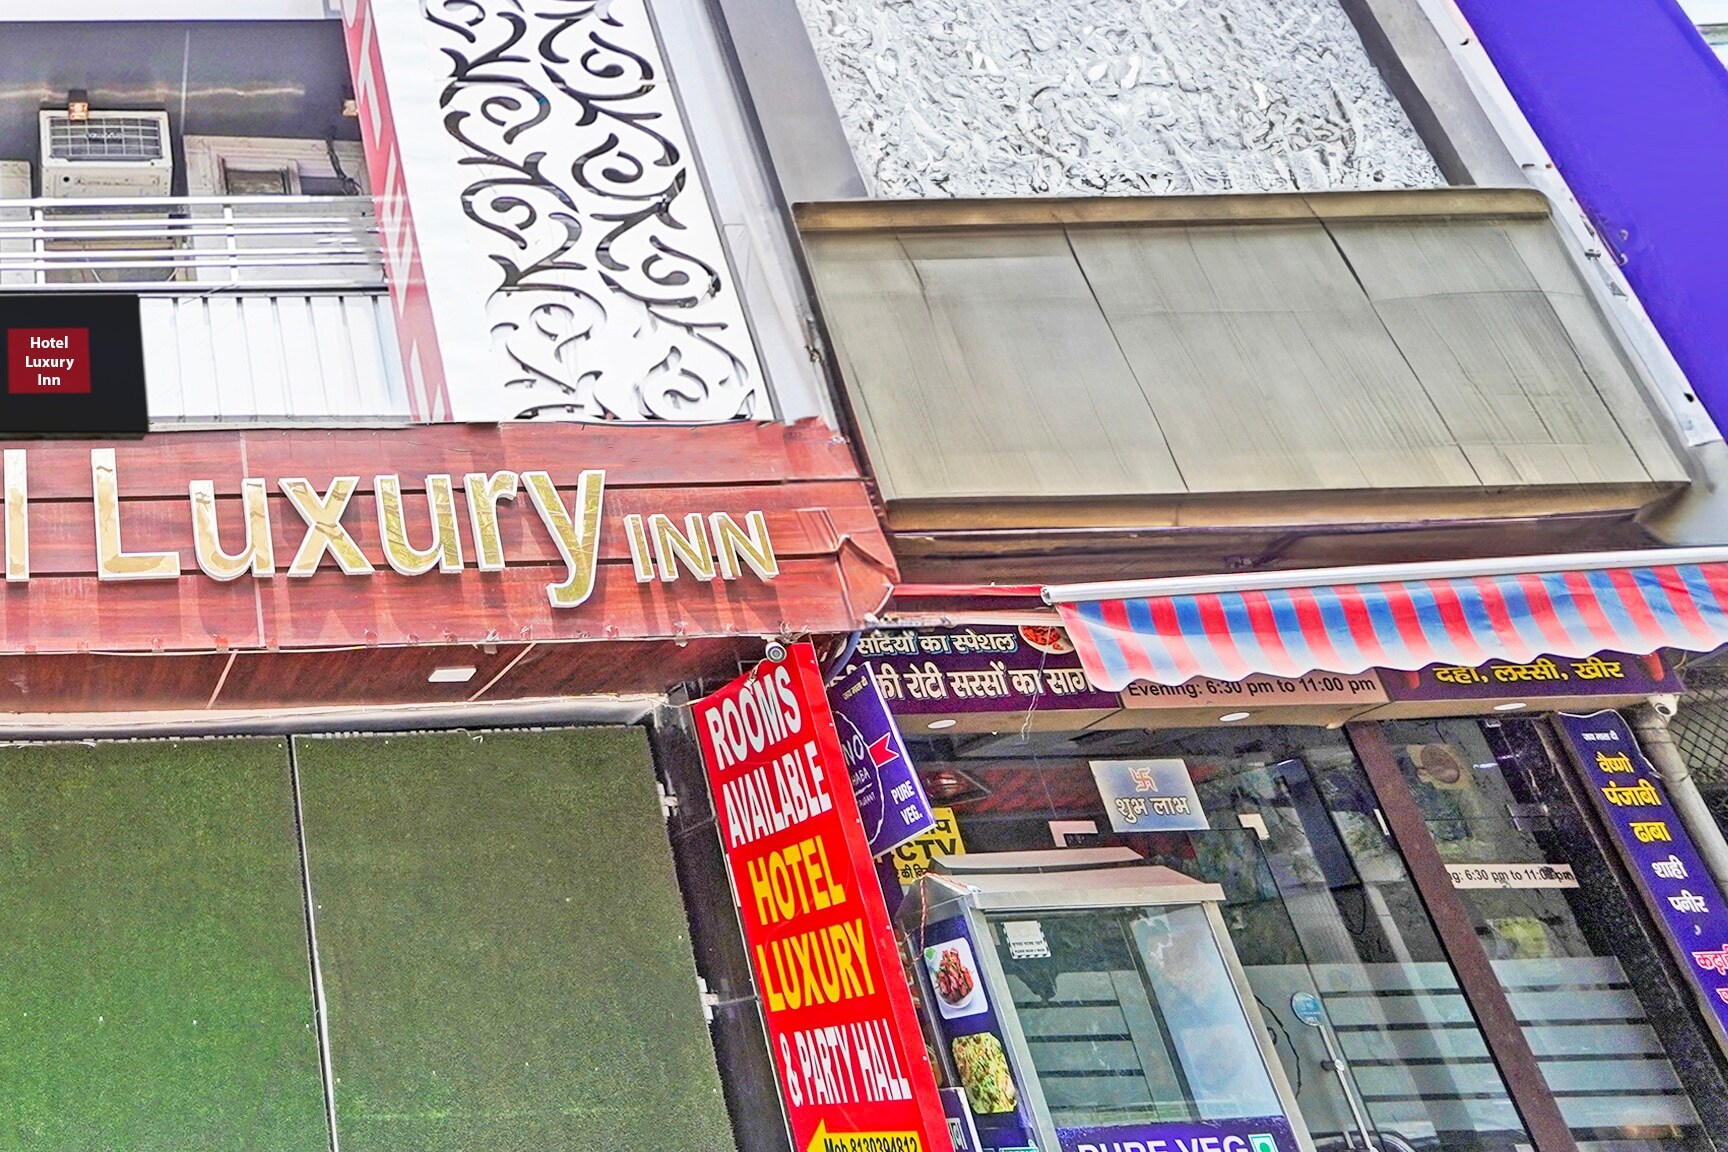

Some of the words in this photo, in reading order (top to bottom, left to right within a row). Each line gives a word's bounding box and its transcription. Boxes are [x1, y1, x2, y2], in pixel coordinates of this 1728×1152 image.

[30, 336, 69, 350] Hotel
[25, 355, 75, 371] Luxury
[38, 373, 61, 386] Inn
[91, 448, 606, 608] Luxury
[624, 510, 780, 585] INN
[917, 634, 950, 653] का
[950, 628, 1017, 654] स्पेशल
[903, 661, 947, 699] रोटी
[947, 660, 1010, 697] सरसों
[1009, 670, 1045, 695] का
[1043, 667, 1097, 694] साग
[1491, 658, 1569, 681] लस्सी,
[1571, 656, 1624, 679] खीर
[1206, 680, 1242, 695] 6:30
[1246, 681, 1274, 697] pm
[1277, 679, 1295, 693] to
[1298, 677, 1344, 692] 11:00
[1349, 677, 1376, 695] pm
[705, 665, 801, 770] ROOMS
[1595, 752, 1635, 774] वैष्णो
[722, 740, 832, 848] AVAILABLE
[890, 780, 915, 805] PURE
[1602, 778, 1662, 807] पंजाबी
[900, 804, 923, 826] VEG.
[1115, 796, 1148, 824] शुभ
[1149, 796, 1192, 816] लाभ
[1629, 820, 1672, 843] ढाबा
[895, 838, 956, 861] CTV
[1465, 869, 1489, 881] 6:30
[1511, 870, 1522, 880] to
[1651, 854, 1688, 880] शाही
[747, 835, 846, 926] HOTEL
[1667, 888, 1709, 913] पनीर
[756, 918, 875, 1012] LUXURY
[779, 1032, 803, 1108] &
[793, 1025, 860, 1106] PARTY
[851, 1018, 912, 1101] HALL
